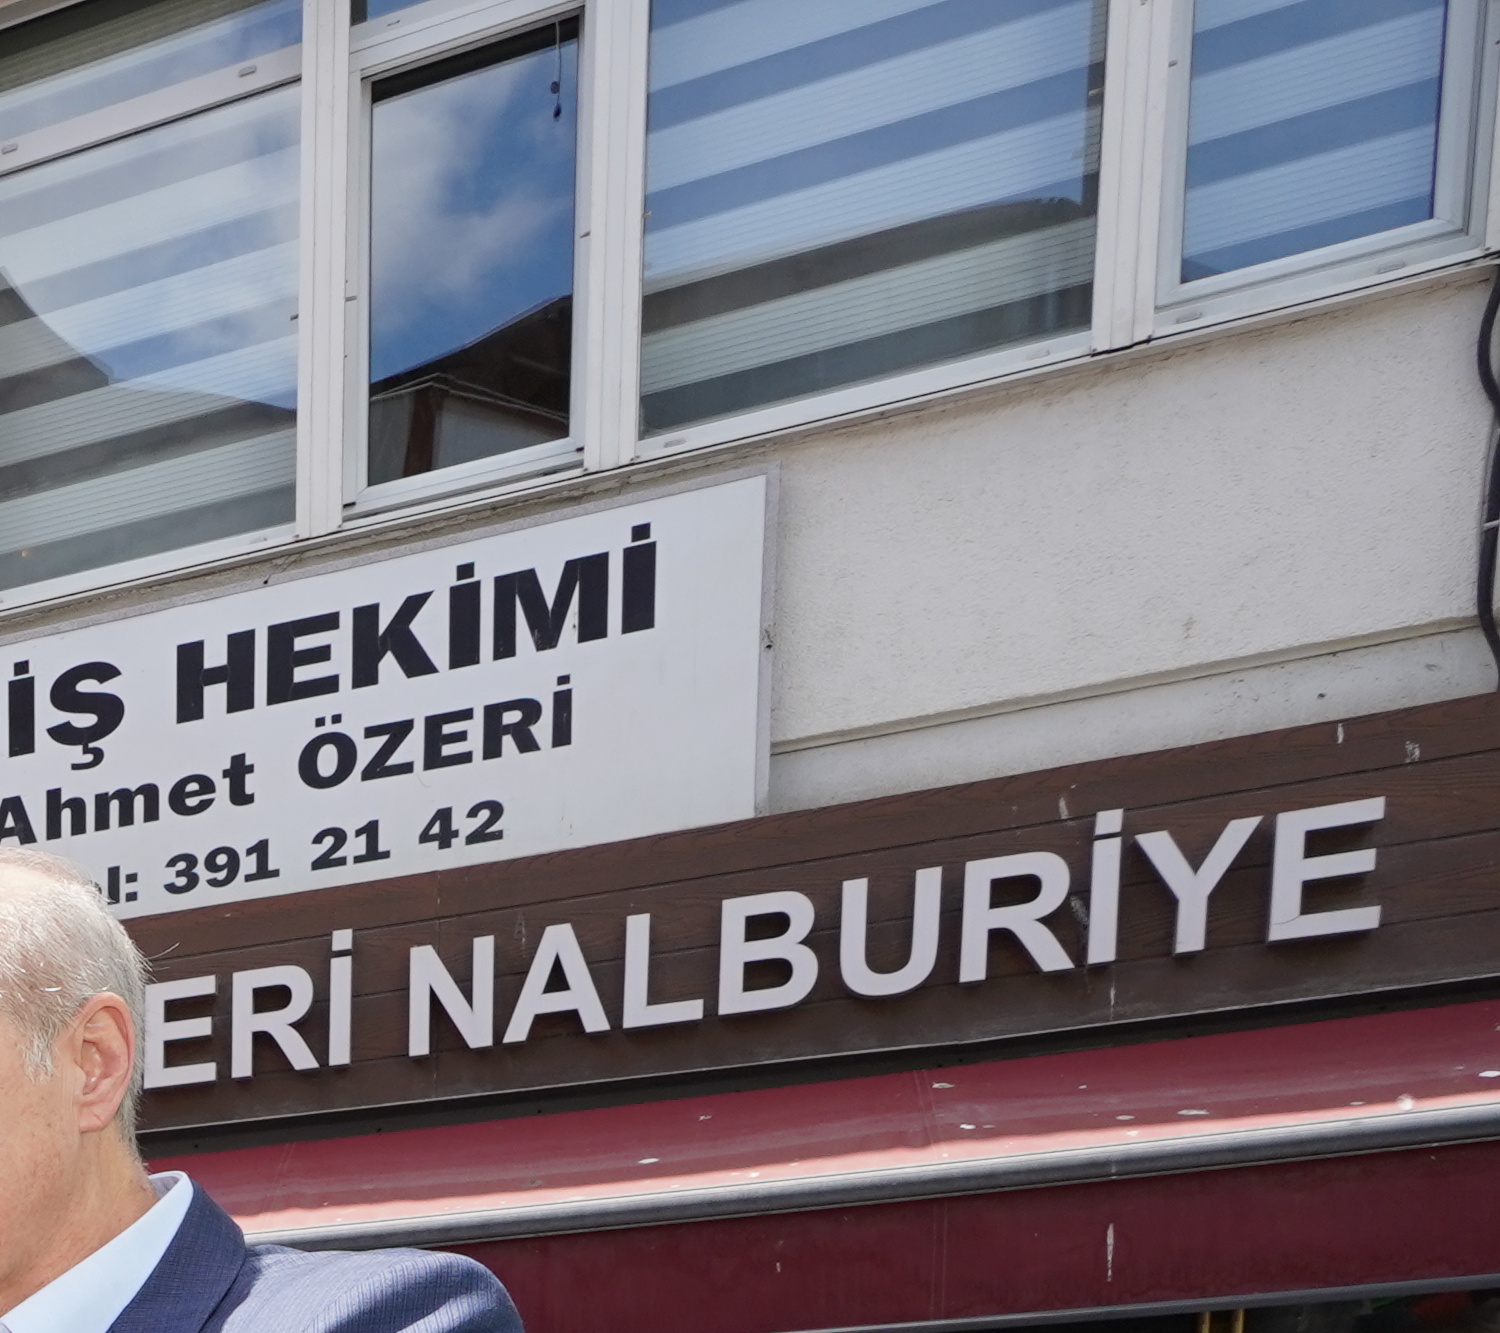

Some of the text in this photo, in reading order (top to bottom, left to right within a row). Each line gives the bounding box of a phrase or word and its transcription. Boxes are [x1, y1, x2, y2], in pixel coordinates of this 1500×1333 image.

[176, 522, 657, 725] HEKİMİ
[297, 673, 574, 790] ÖZERİ
[163, 838, 280, 896] 391
[310, 817, 391, 872] 21
[418, 799, 505, 852] 42
[143, 796, 1387, 1090] ERİ NALBURİYE
